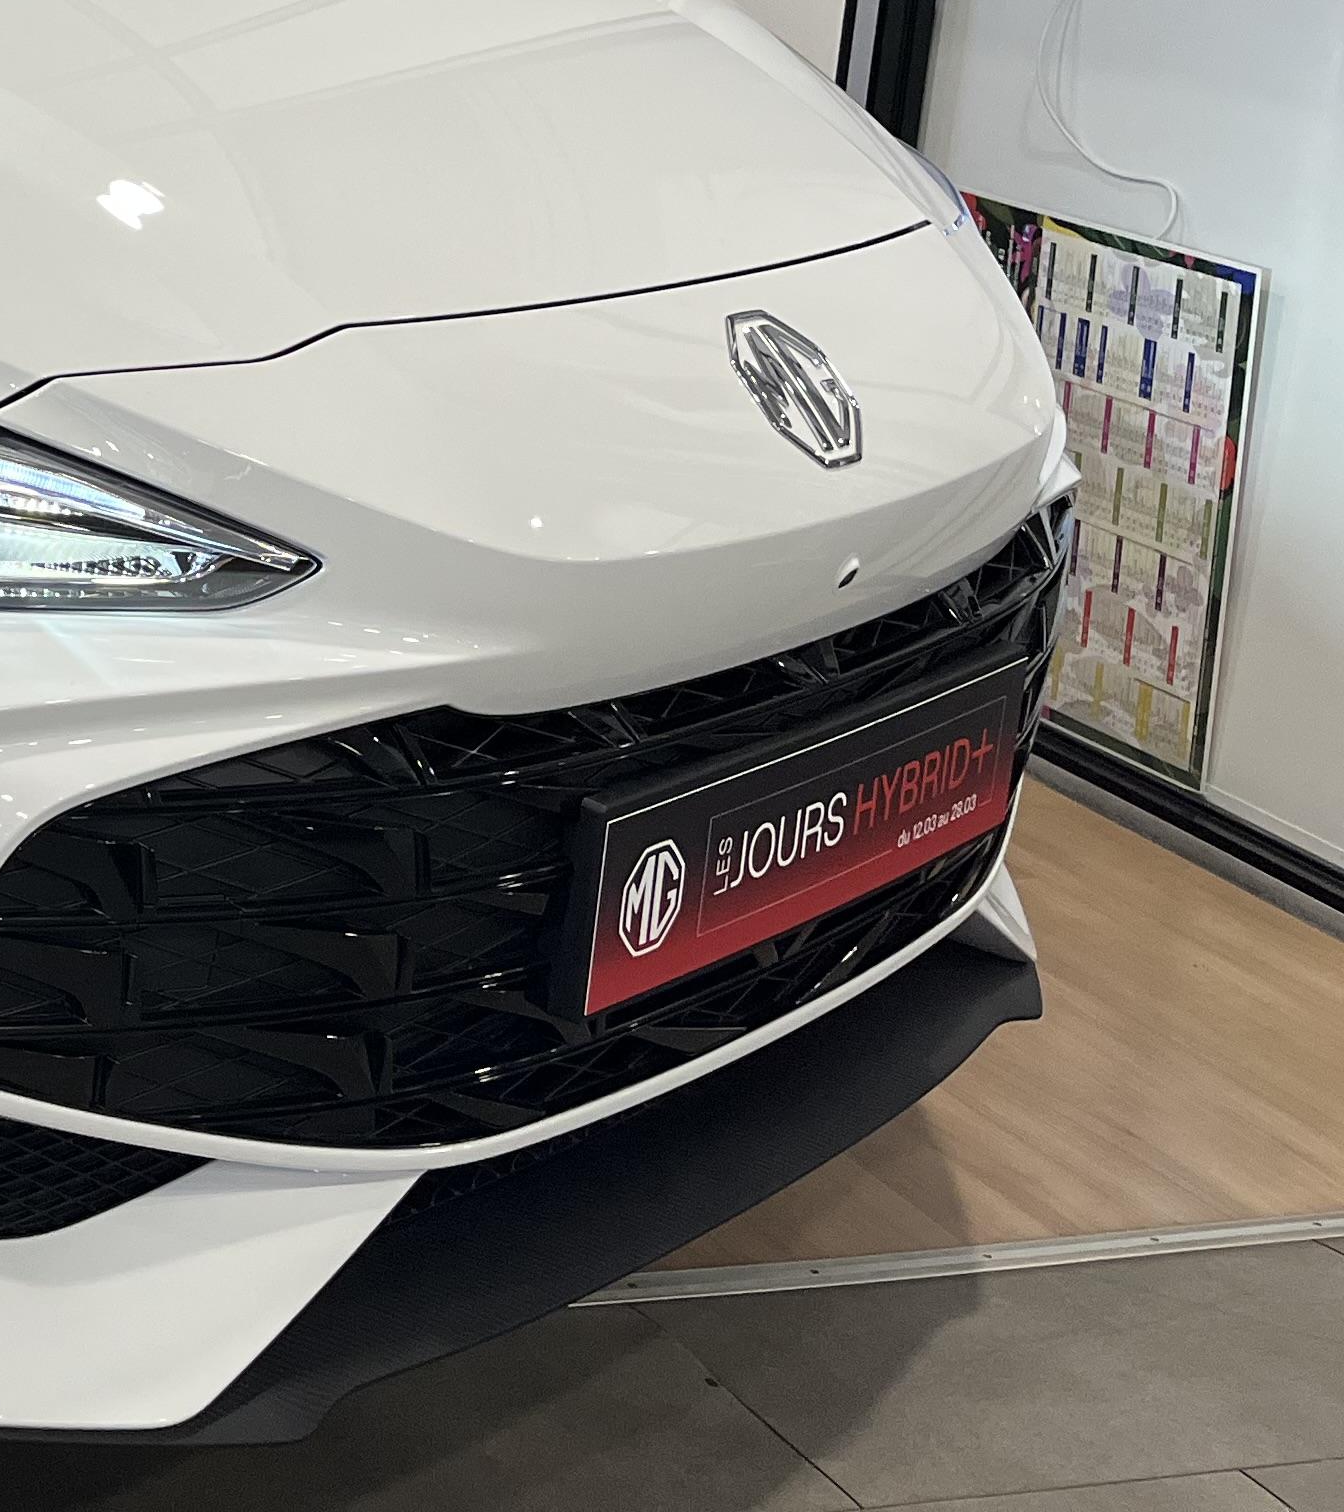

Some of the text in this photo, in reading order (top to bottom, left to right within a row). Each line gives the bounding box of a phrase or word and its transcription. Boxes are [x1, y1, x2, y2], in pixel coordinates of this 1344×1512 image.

[742, 324, 852, 452] MG
[713, 728, 994, 896] LES JOURS HYBRID+
[897, 793, 978, 849] du 12.03 au 28.03
[625, 850, 679, 946] MG
